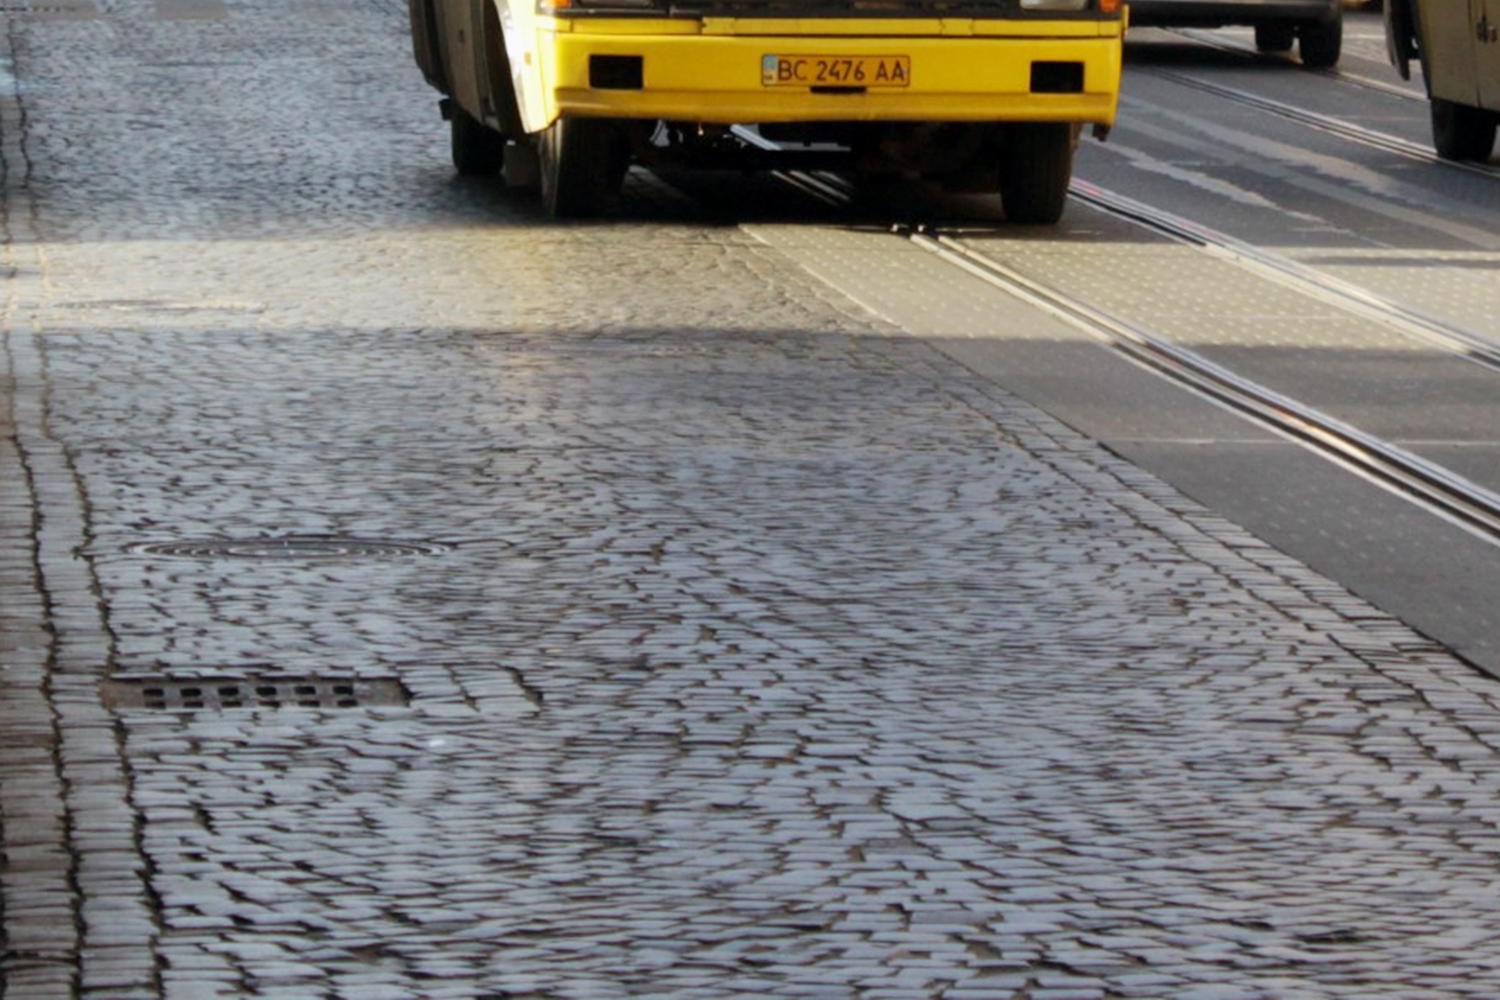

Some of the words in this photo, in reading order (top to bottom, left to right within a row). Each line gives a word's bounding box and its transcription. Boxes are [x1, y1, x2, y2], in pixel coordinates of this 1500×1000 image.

[777, 60, 808, 81] BC
[815, 60, 866, 82] 2476
[874, 60, 906, 81] AA
